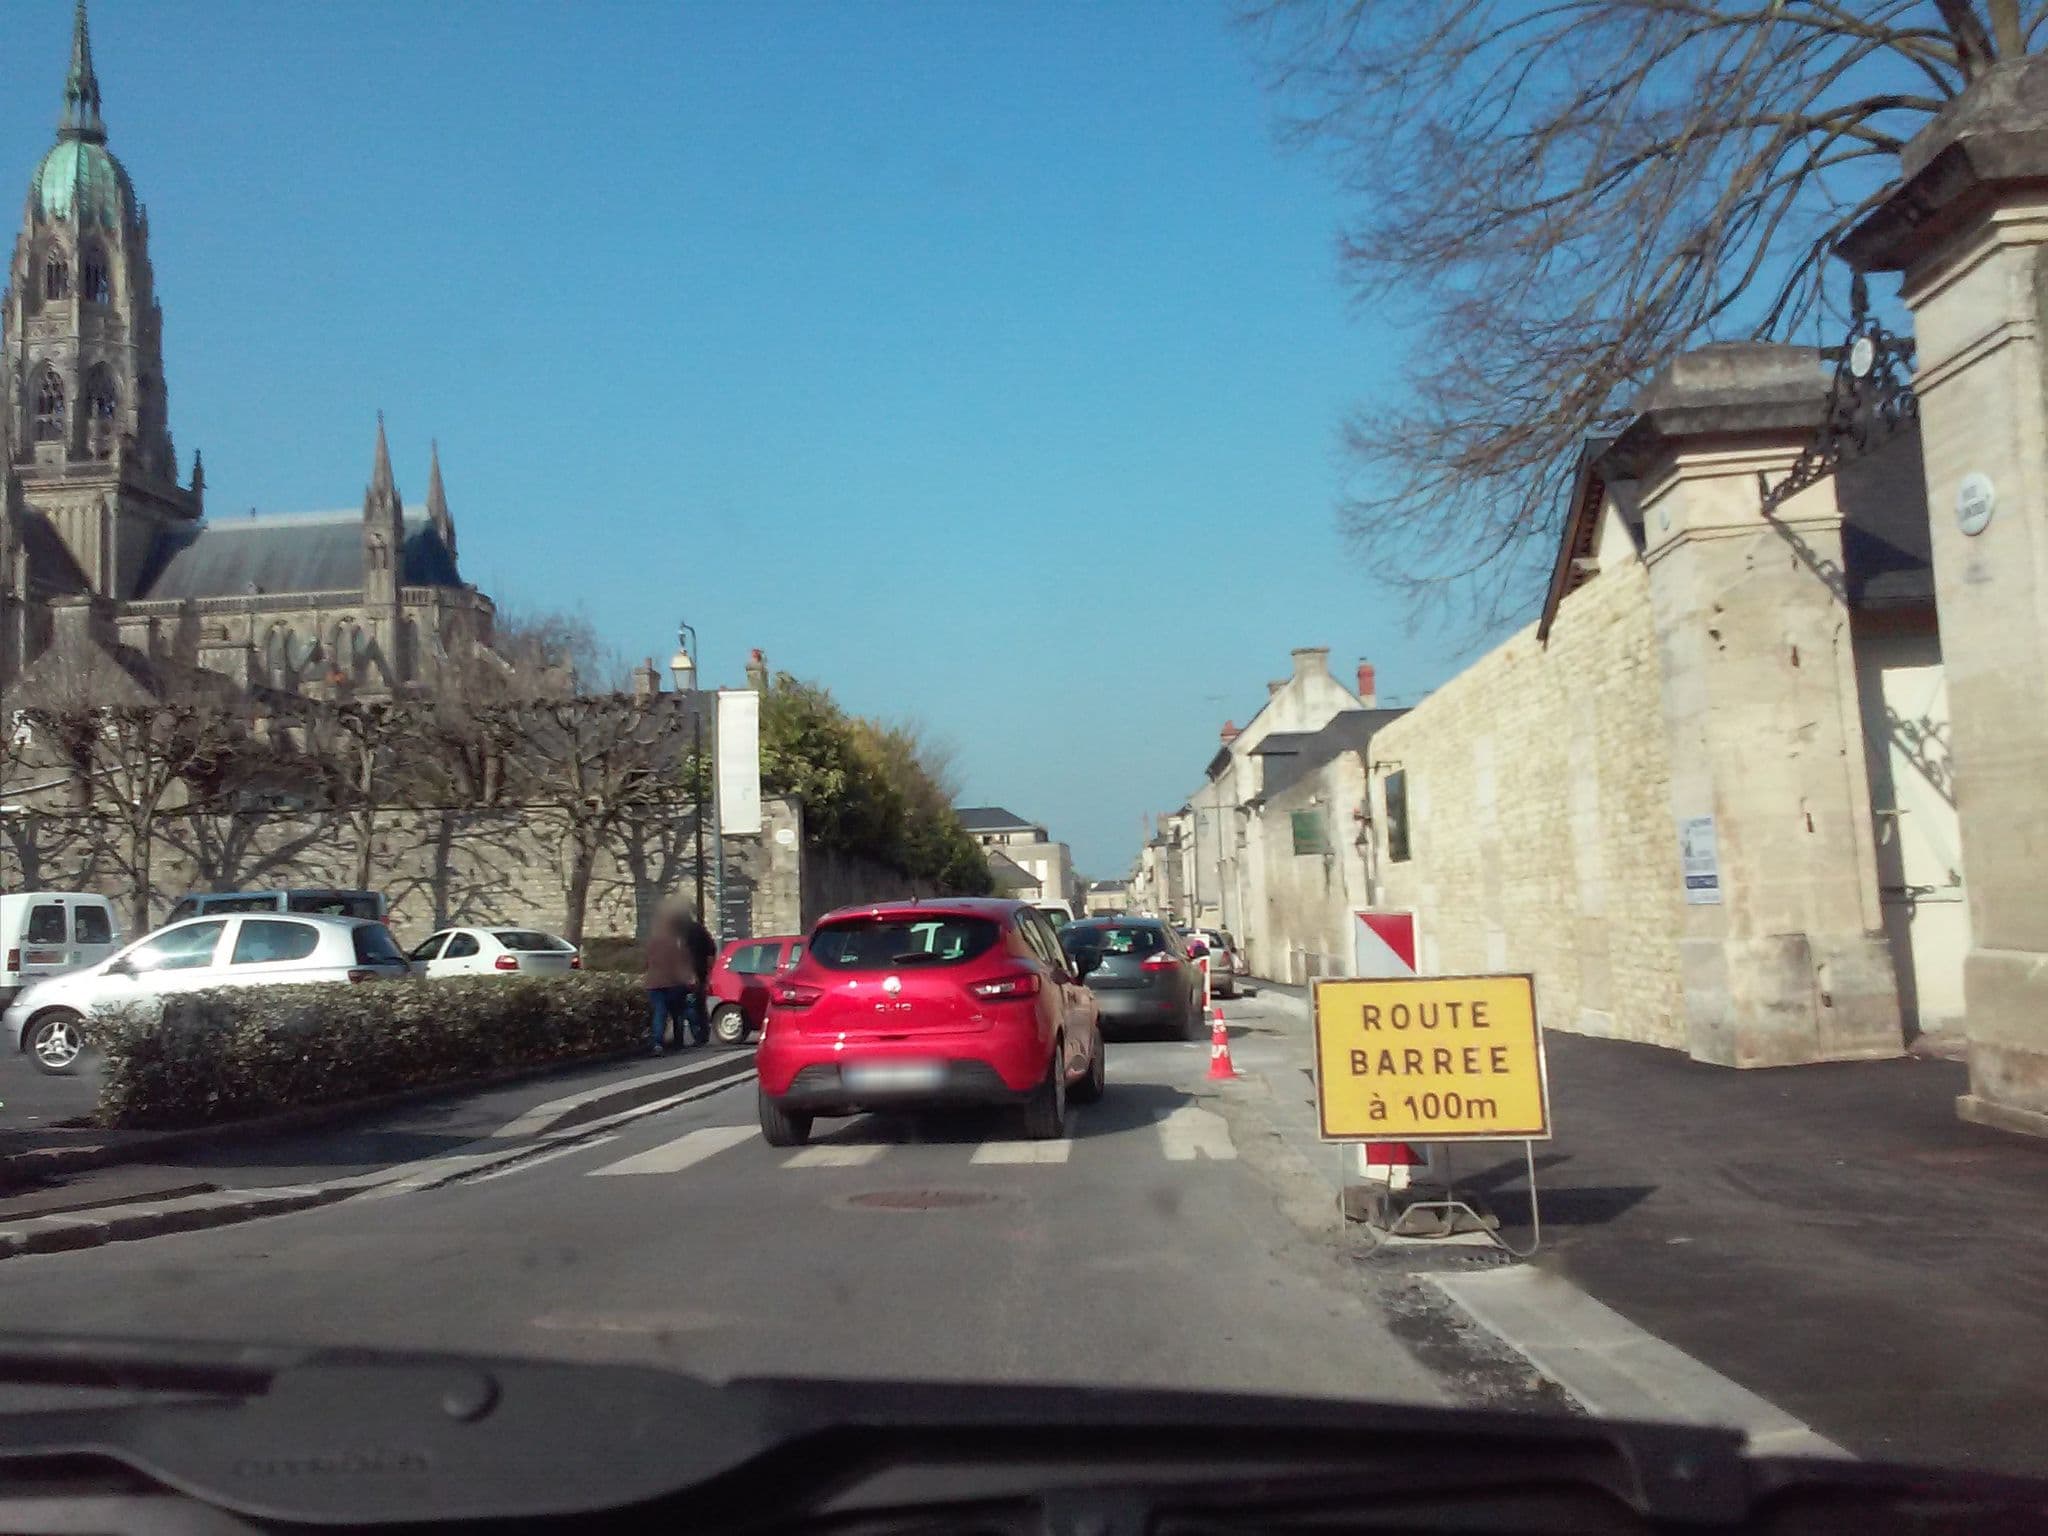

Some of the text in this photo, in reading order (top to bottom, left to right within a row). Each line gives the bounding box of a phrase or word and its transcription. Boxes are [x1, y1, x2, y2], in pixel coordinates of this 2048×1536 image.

[1362, 1001, 1490, 1031] ROUTE
[1350, 1046, 1510, 1076] BARREE
[1368, 1092, 1498, 1121] à 100m
